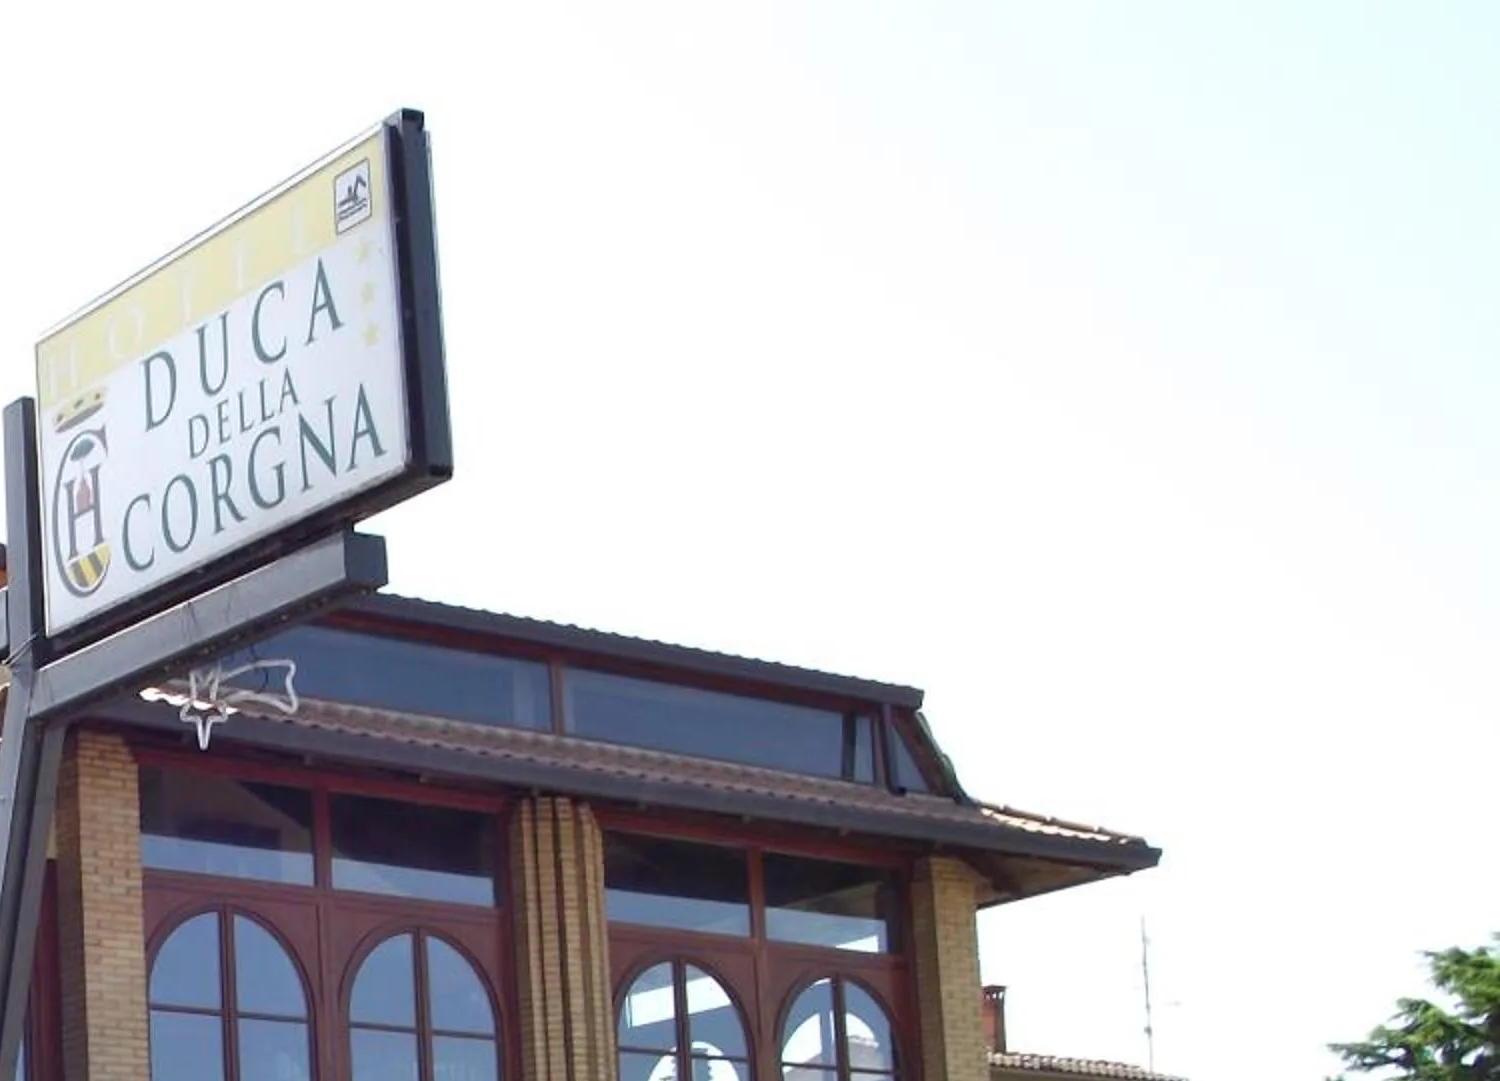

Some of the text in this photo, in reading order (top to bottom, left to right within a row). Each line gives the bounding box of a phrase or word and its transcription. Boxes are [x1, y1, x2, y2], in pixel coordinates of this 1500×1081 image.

[139, 256, 345, 432] DUCA
[188, 367, 300, 459] DELLA
[121, 382, 386, 572] CORGNA
